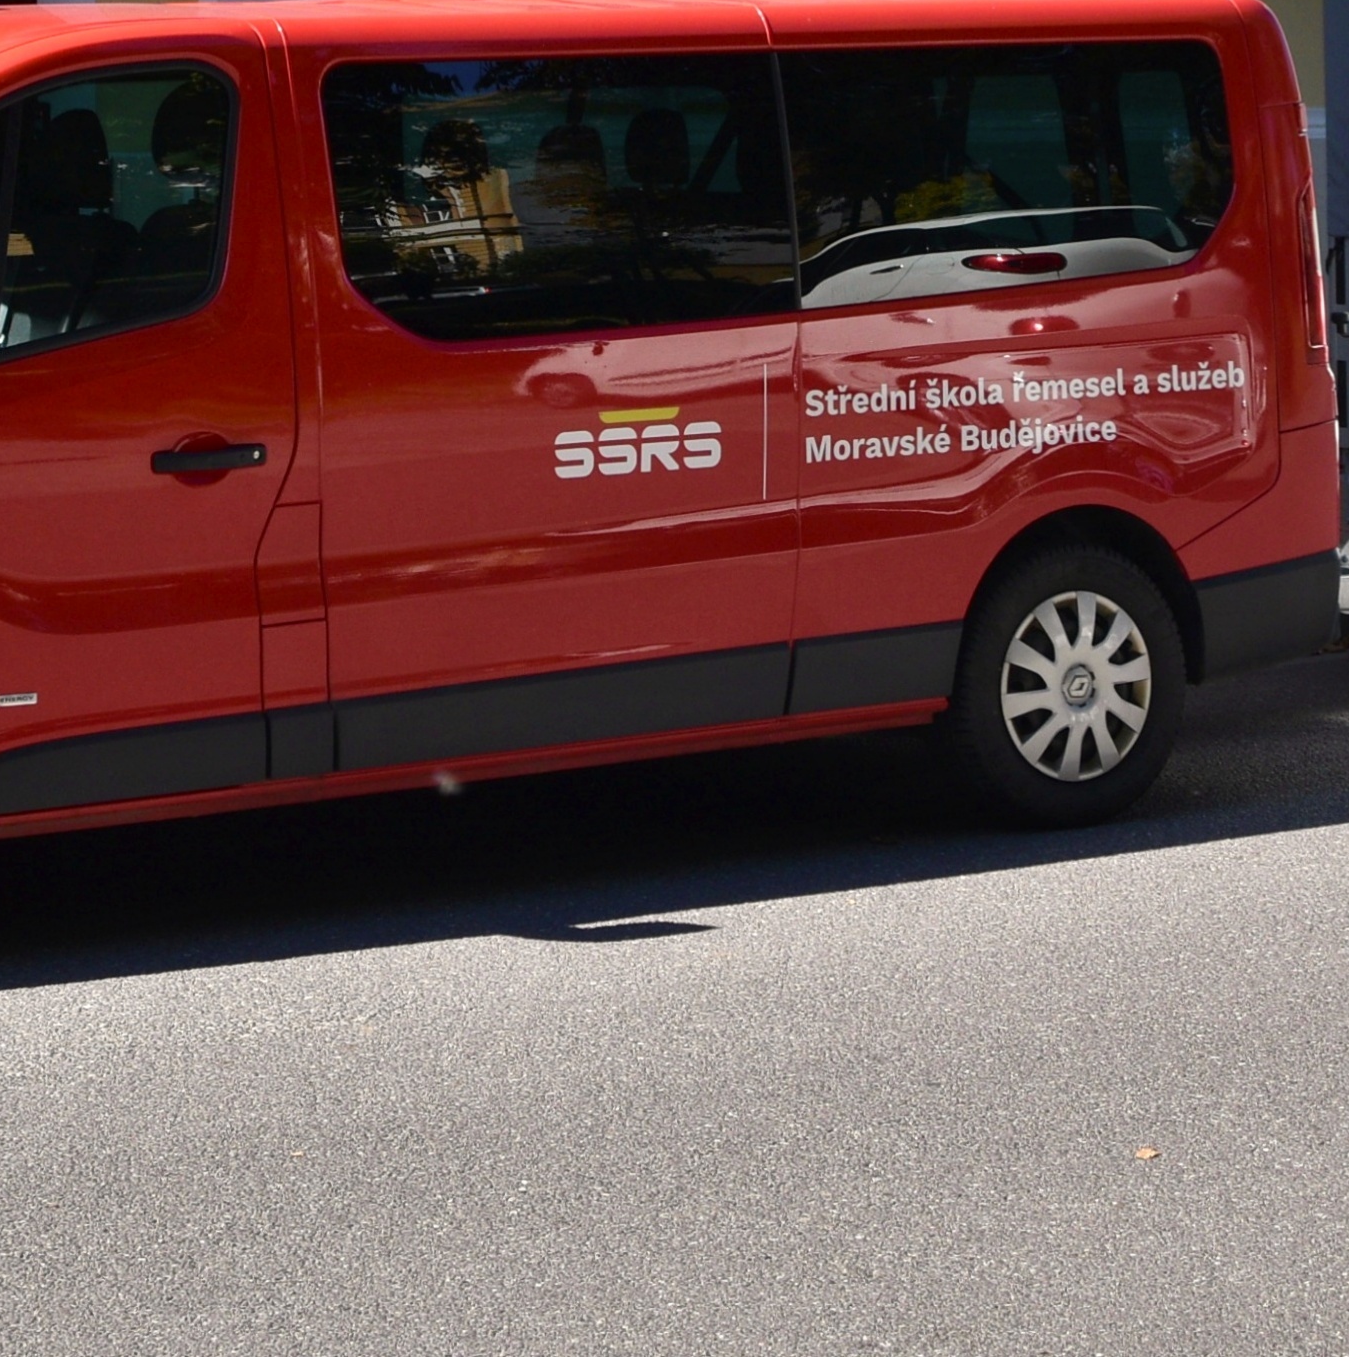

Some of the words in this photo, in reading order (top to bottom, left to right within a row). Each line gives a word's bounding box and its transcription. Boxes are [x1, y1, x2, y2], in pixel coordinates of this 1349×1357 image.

[805, 379, 916, 417] Střední
[925, 377, 1004, 410] škola
[1013, 368, 1126, 402] řemesel
[1133, 374, 1150, 394] a
[1157, 361, 1245, 393] služeb
[554, 421, 722, 479] SSRS
[805, 424, 951, 464] Moravské
[961, 415, 1117, 454] Budějovice
